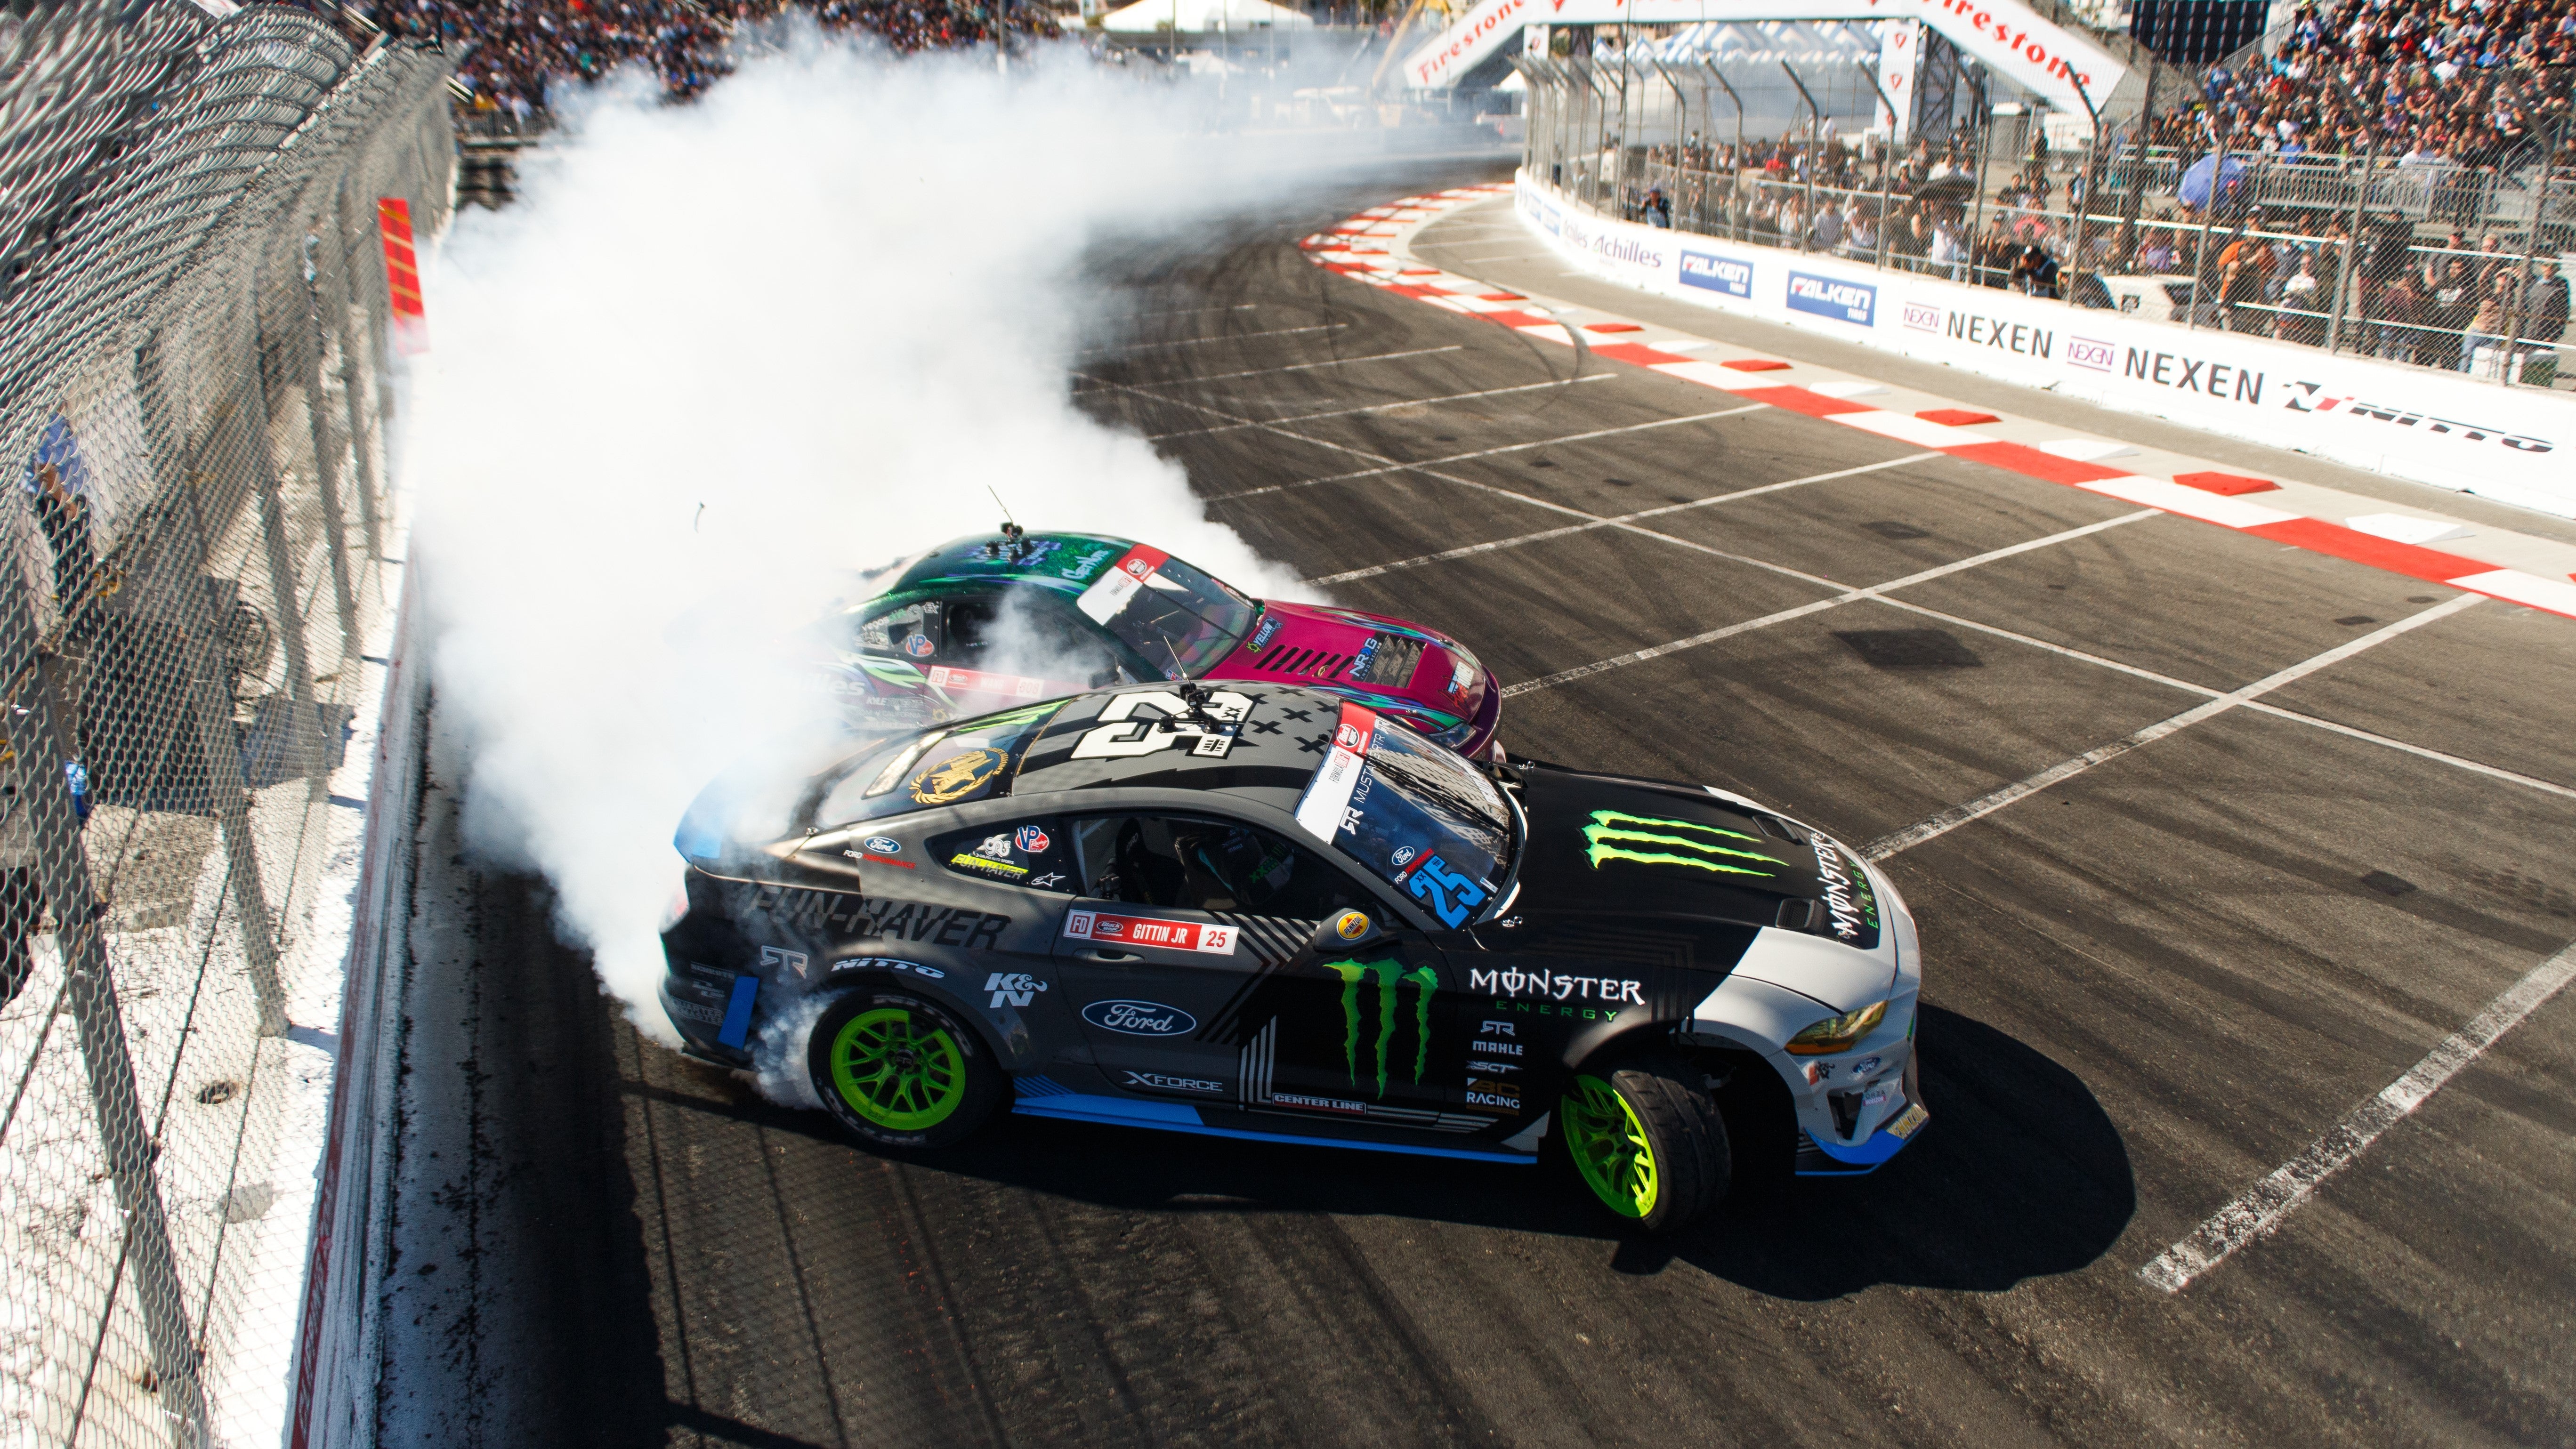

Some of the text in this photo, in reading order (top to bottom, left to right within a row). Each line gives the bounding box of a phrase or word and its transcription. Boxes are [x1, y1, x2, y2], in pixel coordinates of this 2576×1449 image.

[1593, 234, 1663, 268] Achilles
[1682, 254, 1750, 282] FALKEN
[1790, 276, 1872, 309] FALKEN
[1946, 311, 2053, 359] NEXEN
[2068, 342, 2265, 405] NEXEN NEXEN
[1253, 621, 1273, 646] YELLOW
[1349, 637, 1377, 676] NRG
[1360, 642, 1382, 679] INNOVATIONS
[1329, 764, 1345, 784] FORMULA
[1017, 825, 1041, 851] VP
[843, 849, 864, 859] FORD
[951, 854, 1025, 880] FUN-HAVER
[1394, 870, 1408, 885] FORD
[1408, 855, 1486, 930] 25
[1849, 860, 1879, 929] ENERGY
[1072, 916, 1227, 948] FD GITTIN JR 25
[1100, 920, 1121, 929] Black
[1343, 915, 1363, 936] PENNZOIL
[830, 957, 945, 979] NITTO
[1496, 1000, 1618, 1023] ENERGY
[1472, 1040, 1523, 1056] MAHLE
[1274, 1094, 1364, 1111] CENTER LINE
[1466, 1092, 1520, 1109] RACING
